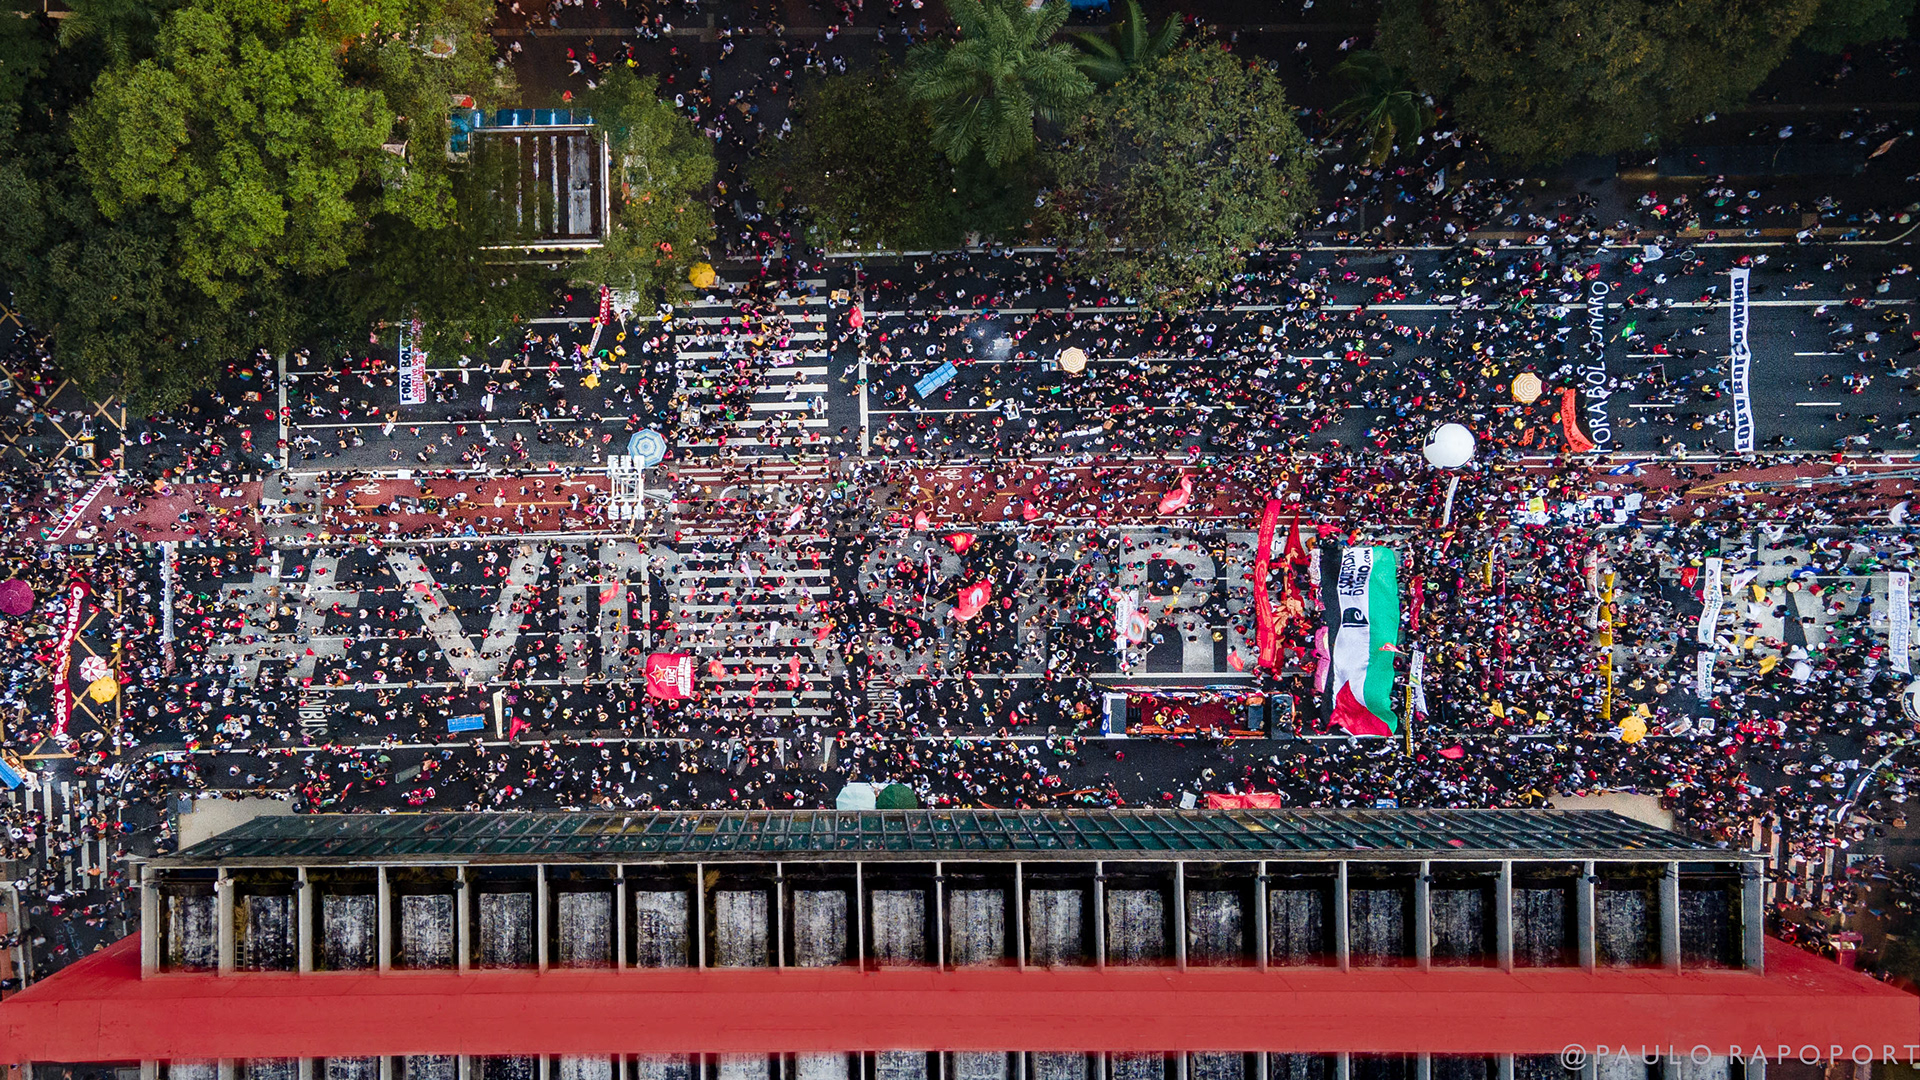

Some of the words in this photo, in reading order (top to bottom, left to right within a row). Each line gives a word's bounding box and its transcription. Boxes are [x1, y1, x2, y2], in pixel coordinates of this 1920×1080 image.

[401, 374, 412, 401] FORA
[1587, 401, 1612, 453] FORA
[51, 504, 84, 538] LULA
[1338, 551, 1356, 596] ESQUERDA
[55, 586, 84, 686] BOLSONARO
[55, 688, 67, 736] FORA
